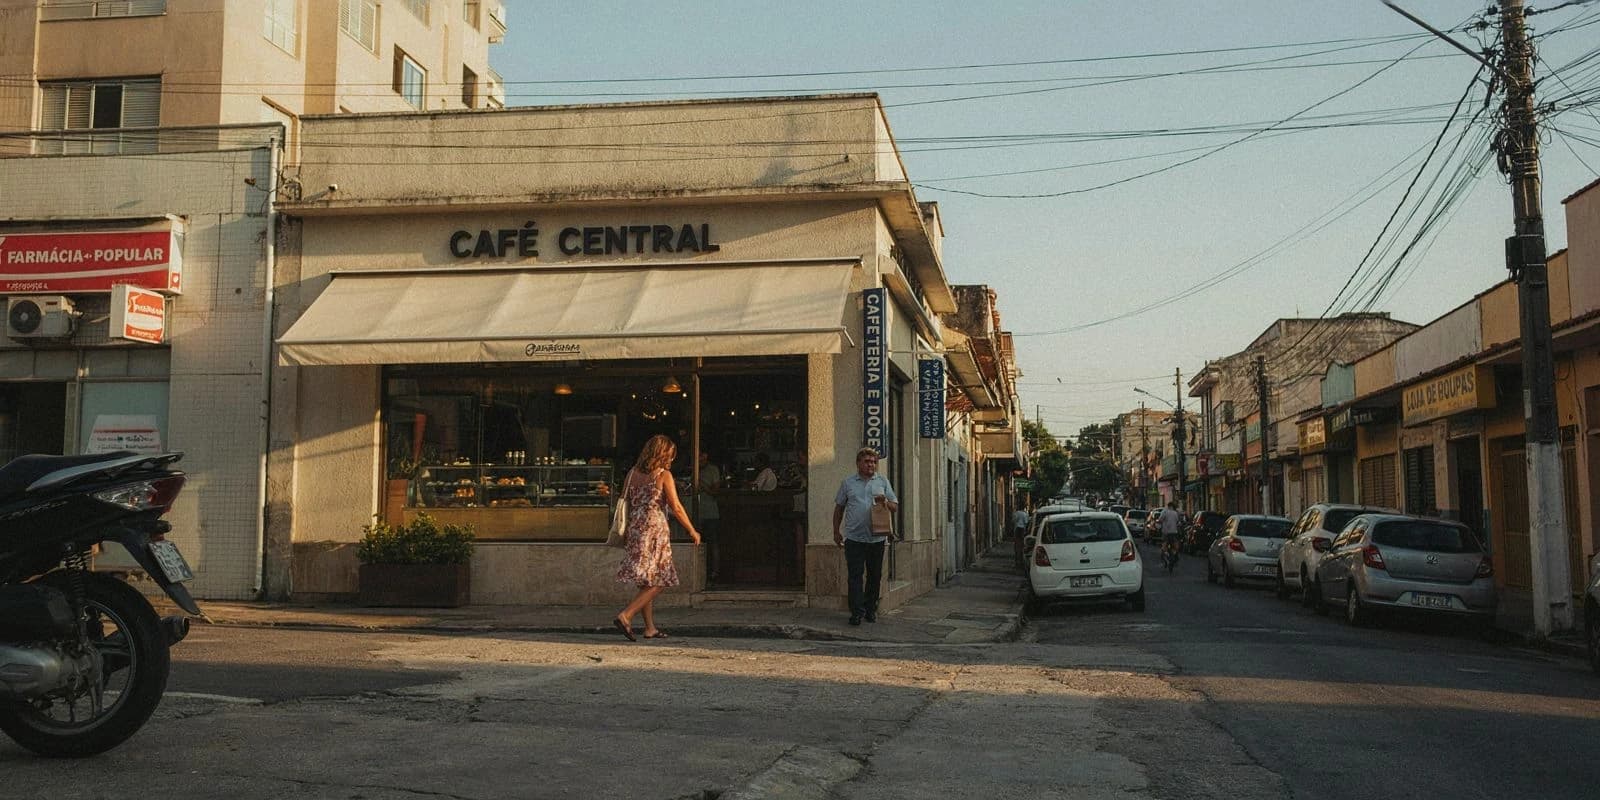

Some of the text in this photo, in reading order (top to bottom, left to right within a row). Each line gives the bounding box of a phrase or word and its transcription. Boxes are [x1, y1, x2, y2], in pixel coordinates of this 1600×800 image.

[450, 221, 720, 257] CAFÉ CENTRAL
[7, 247, 163, 264] FARMÁCIA POPULAR
[867, 294, 880, 383] CAFETERIA
[868, 389, 880, 398] E
[1426, 386, 1437, 404] DE
